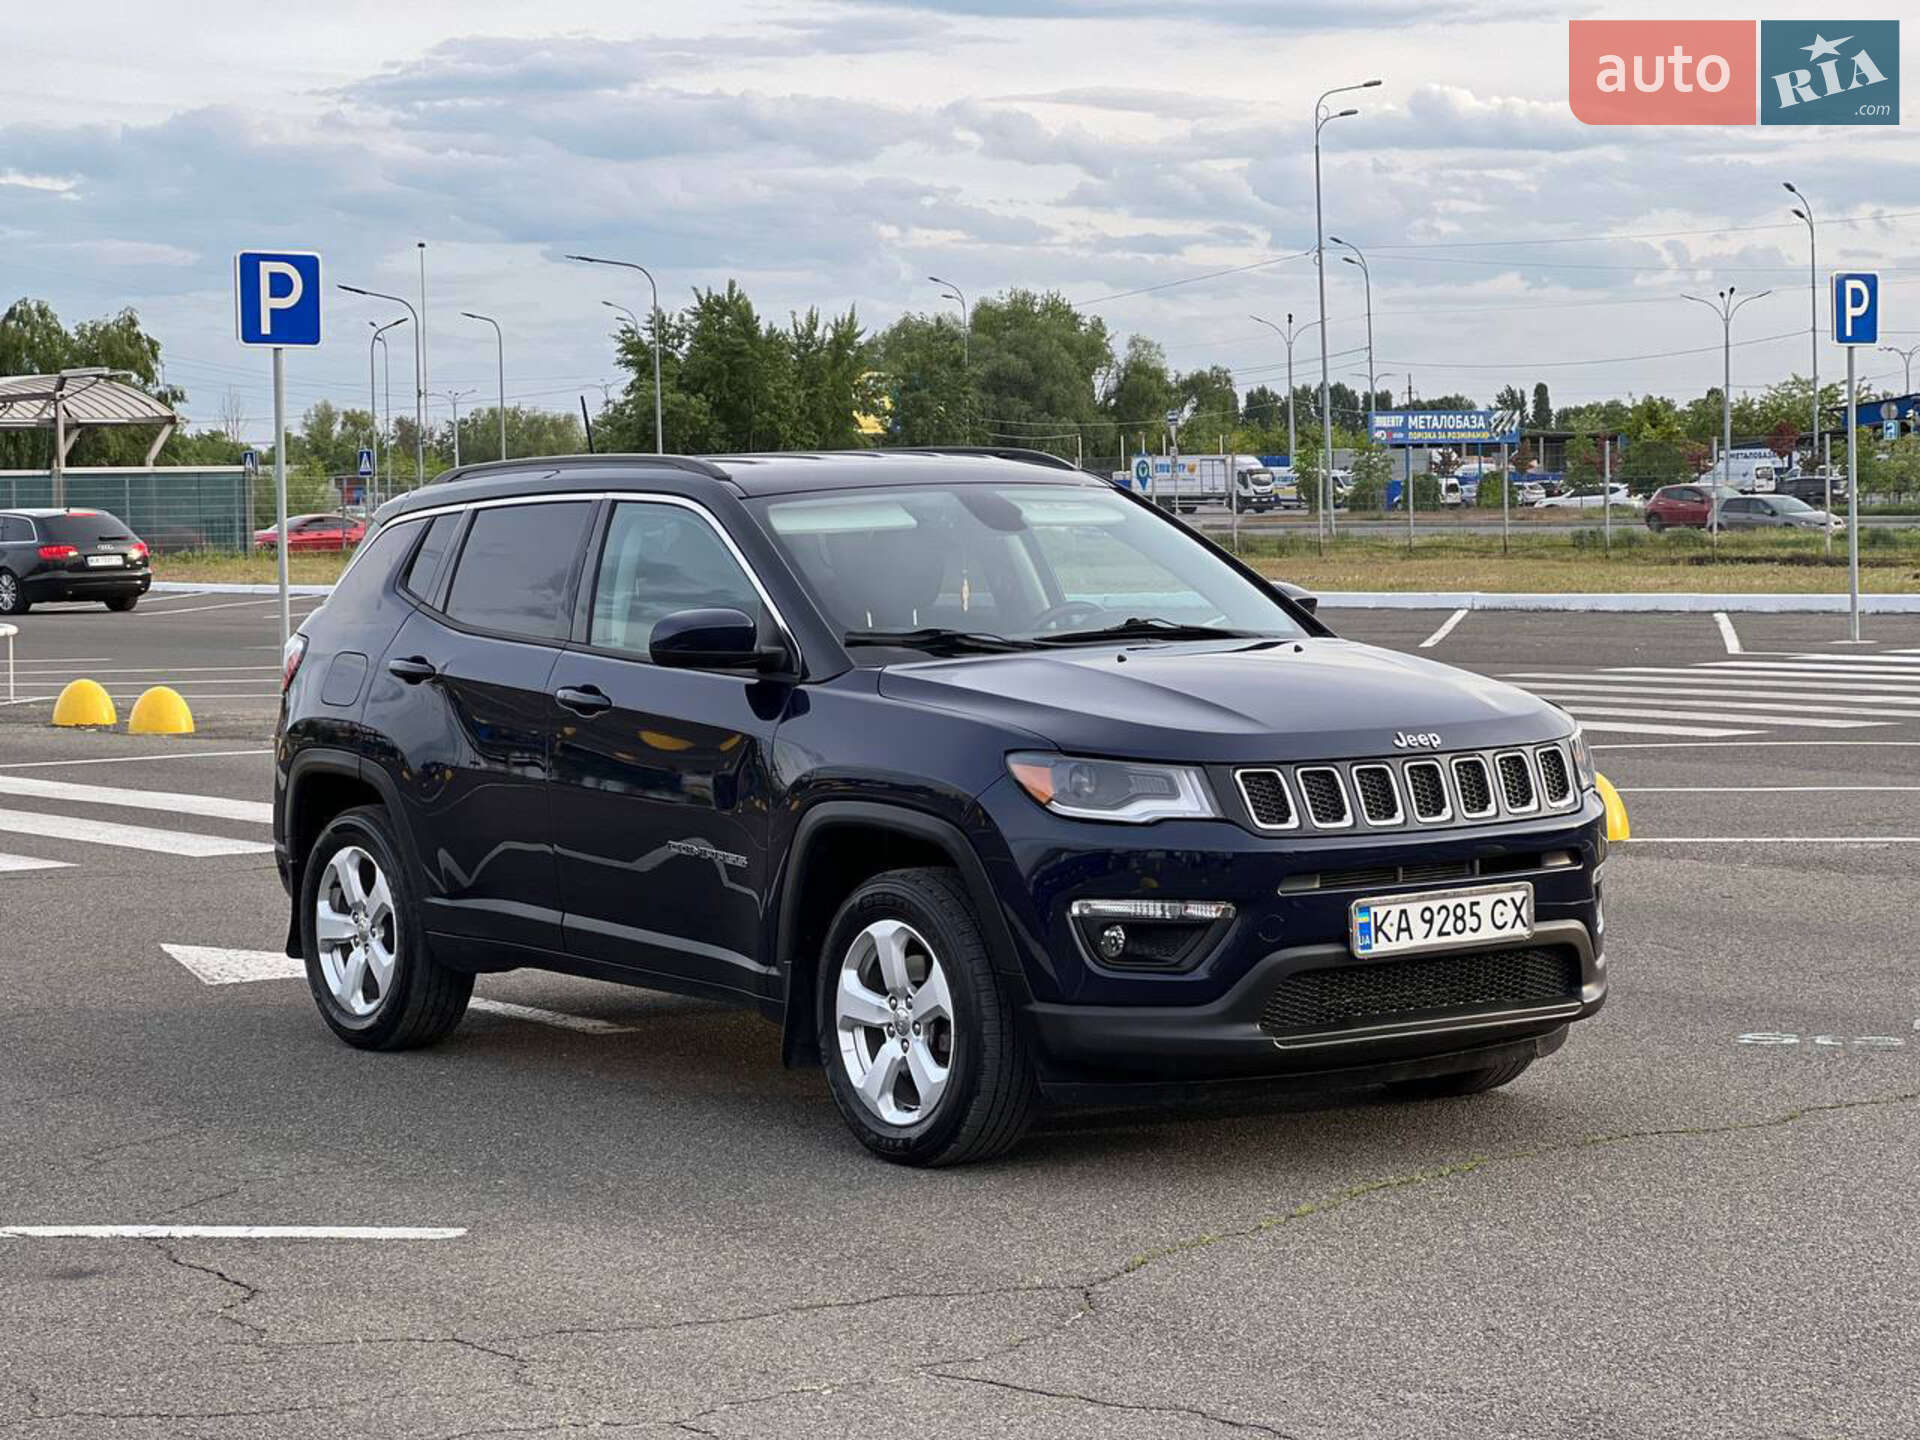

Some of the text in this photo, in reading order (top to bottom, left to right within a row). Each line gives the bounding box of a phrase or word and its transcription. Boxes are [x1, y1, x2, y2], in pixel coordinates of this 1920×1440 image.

[259, 261, 303, 335] P
[1845, 280, 1869, 336] P
[1408, 414, 1486, 429] МЕТАЛОБАЗА
[1393, 731, 1441, 748] Jeep
[1373, 896, 1528, 944] KA 9285 CX
[1359, 935, 1371, 946] UA
